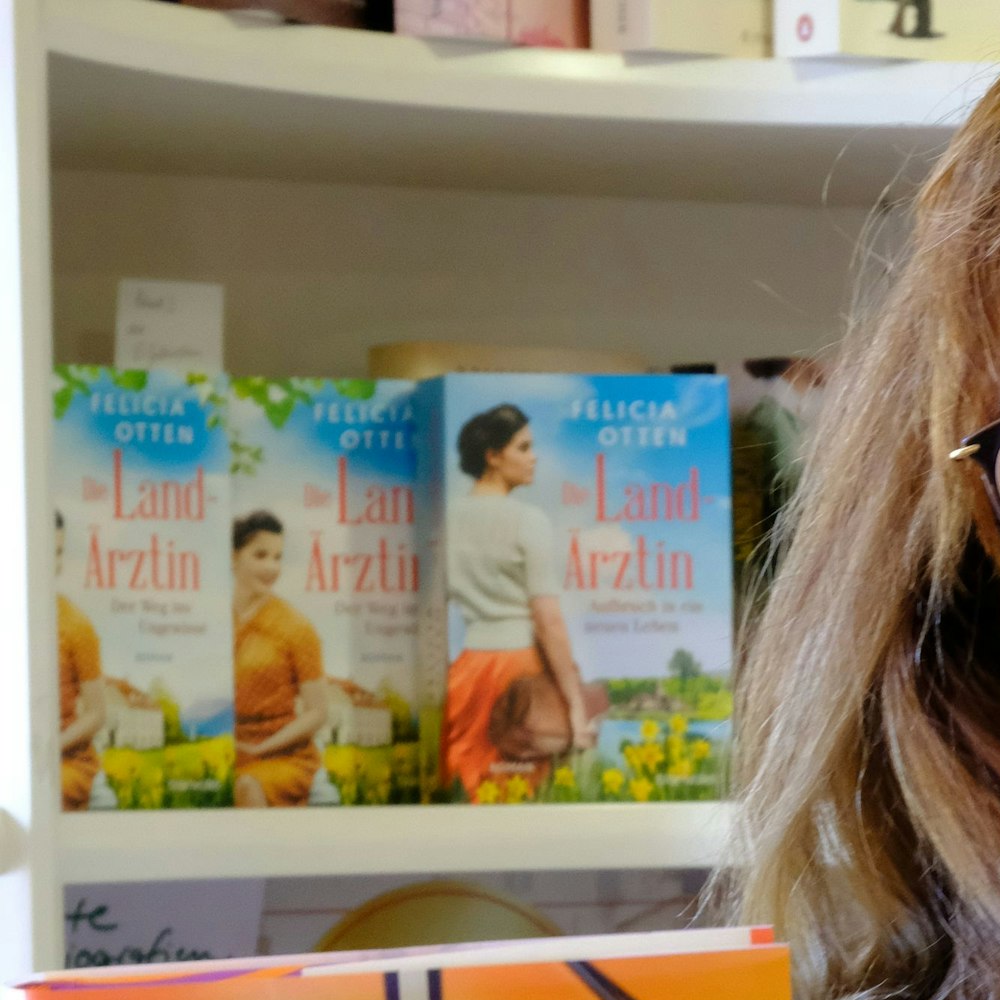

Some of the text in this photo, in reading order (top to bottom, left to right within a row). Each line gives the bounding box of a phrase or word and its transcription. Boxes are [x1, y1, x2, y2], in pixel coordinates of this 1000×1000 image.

[91, 393, 185, 416] FELICIA
[571, 399, 677, 421] FELICIA
[114, 421, 194, 445] OTTEN
[340, 428, 405, 450] OTTE
[598, 425, 687, 447] OTTEN
[114, 449, 217, 521] Land-
[337, 455, 414, 525] Lan
[596, 453, 715, 522] Land-
[84, 524, 200, 591] Ärztin
[563, 527, 694, 591] Ärztin
